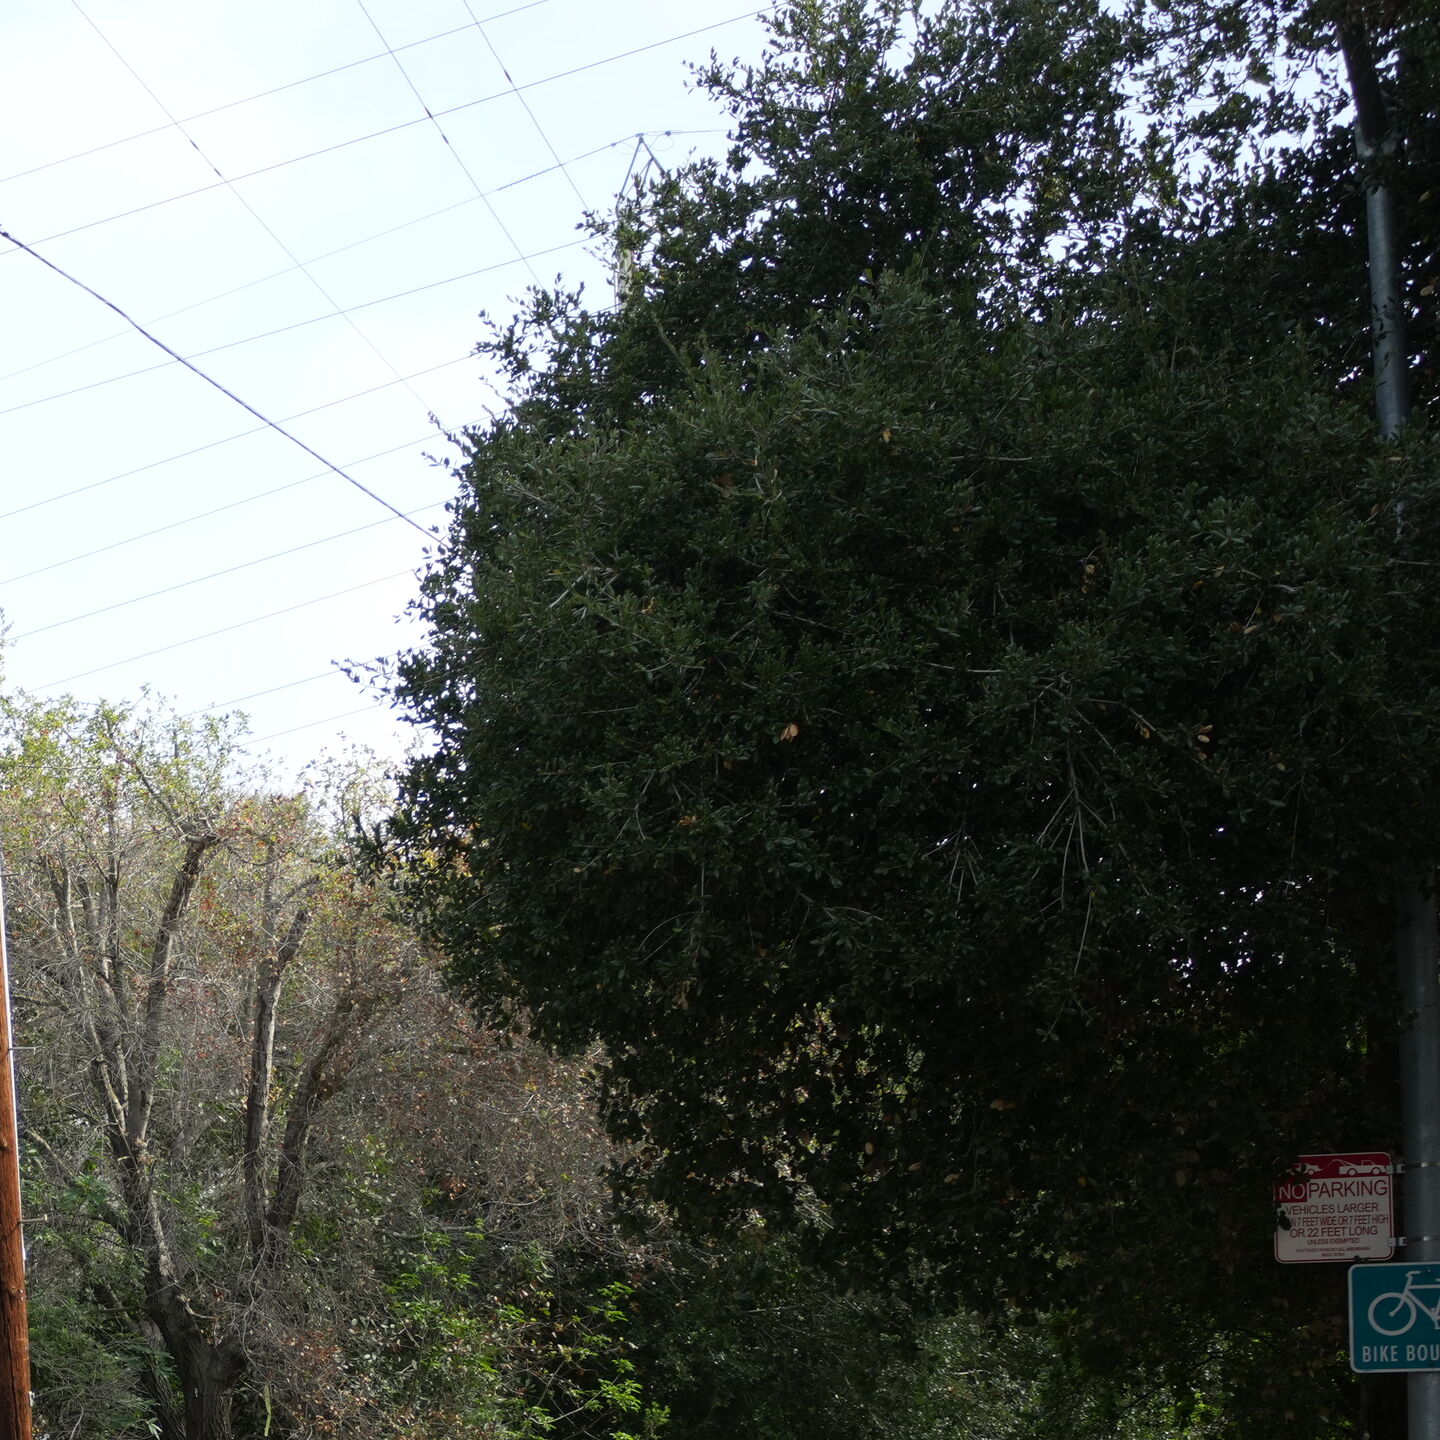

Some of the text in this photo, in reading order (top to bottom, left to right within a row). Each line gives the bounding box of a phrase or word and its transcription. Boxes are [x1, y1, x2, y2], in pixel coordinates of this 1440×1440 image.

[1279, 1180, 1387, 1200] NO PARKING
[1286, 1203, 1379, 1215] VEHICLES LARGER
[1303, 1217, 1318, 1226] FEET
[1321, 1216, 1337, 1226] WIDE
[1338, 1216, 1349, 1225] OR
[1355, 1215, 1370, 1224] FEET
[1372, 1215, 1388, 1224] HIGH
[1290, 1226, 1378, 1238] OR 22 FEET LONG
[1362, 1345, 1399, 1363] BIKE
